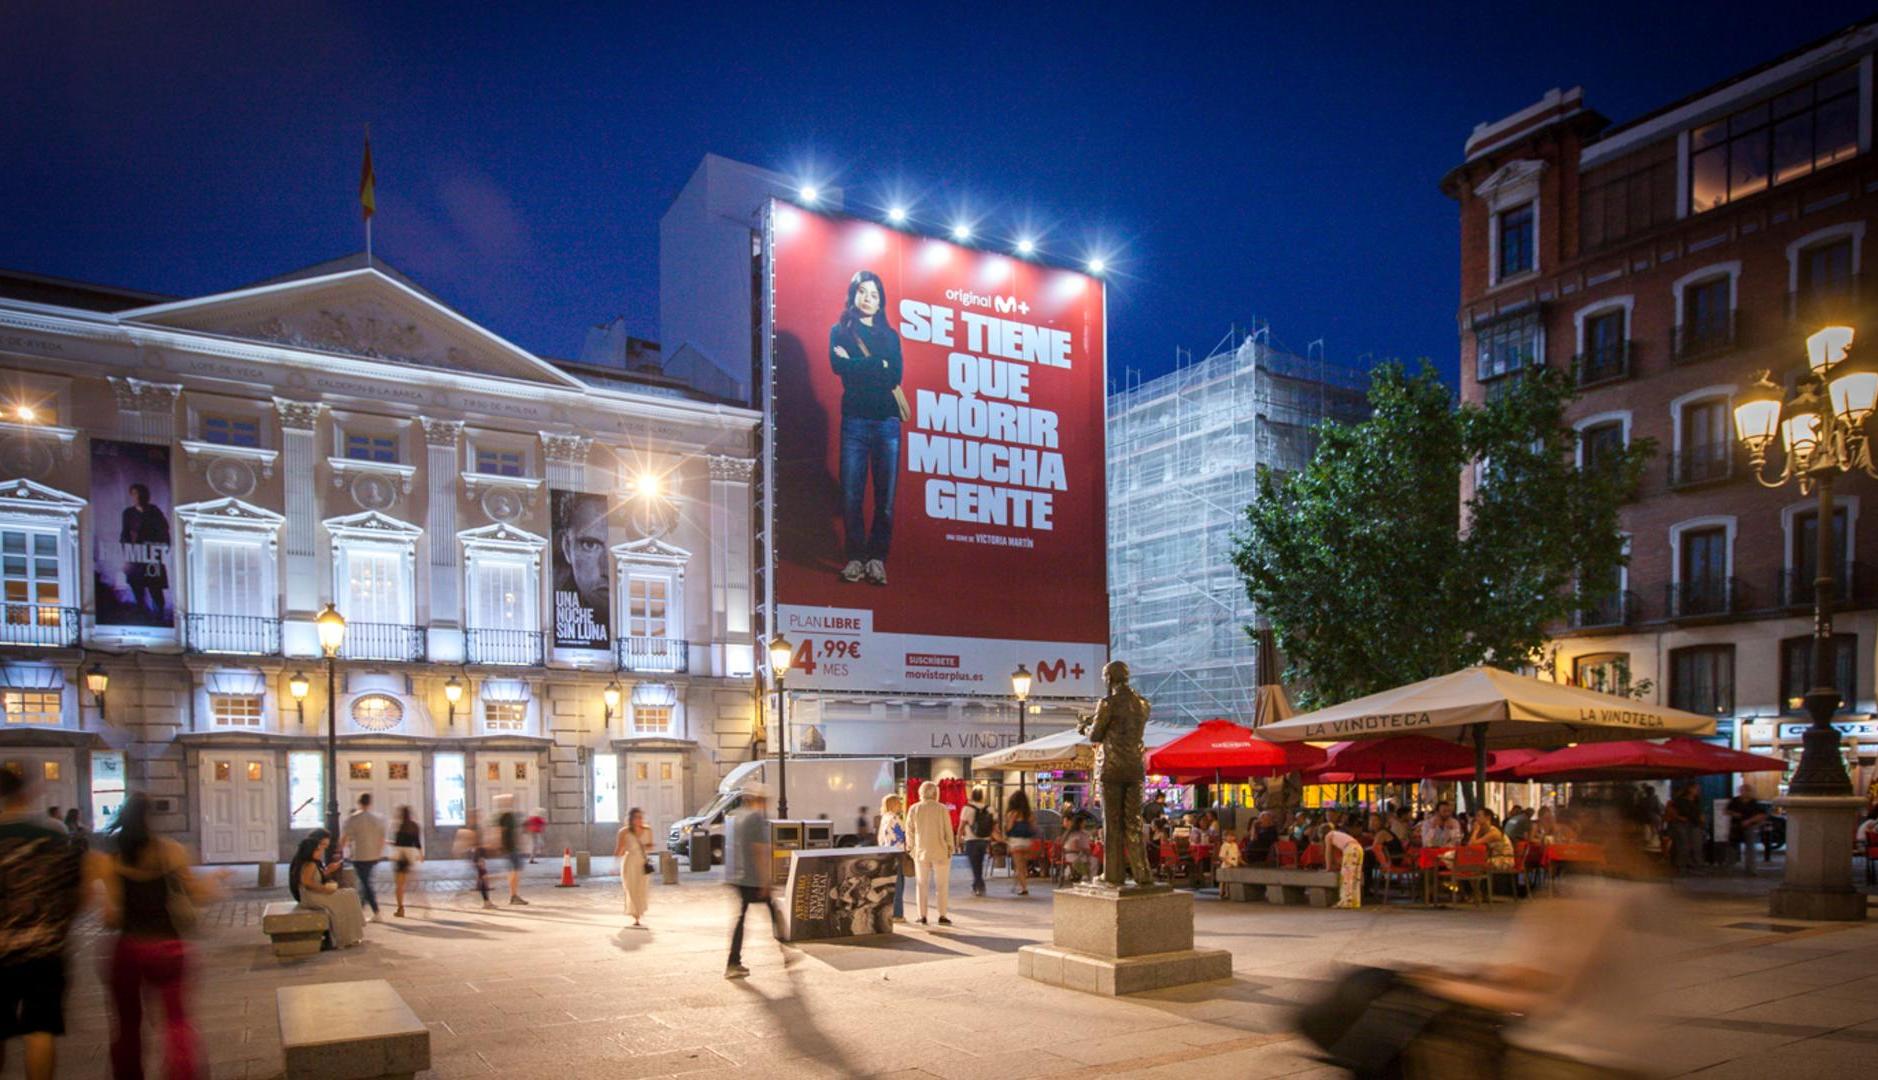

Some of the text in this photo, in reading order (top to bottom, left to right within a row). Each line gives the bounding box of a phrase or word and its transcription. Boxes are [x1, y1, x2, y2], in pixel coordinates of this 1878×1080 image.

[945, 288, 992, 308] original
[899, 298, 1072, 370] SE TIENE
[947, 351, 1030, 403] QUE
[916, 388, 1059, 449] MORIR
[907, 431, 1069, 492] MUCHA
[925, 478, 1054, 531] GENTE
[975, 533, 1008, 546] VICTORIA
[555, 590, 580, 608] UNA
[556, 606, 595, 625] NOCHE
[789, 614, 862, 630] PLAN LIBRE
[556, 622, 608, 641] SIN LUNA
[823, 663, 849, 677] MES
[904, 668, 985, 683] movistarplus.es
[1306, 712, 1431, 737] LA VINOTECA
[1580, 708, 1665, 728] LA VINOTECA
[930, 732, 951, 749] LA
